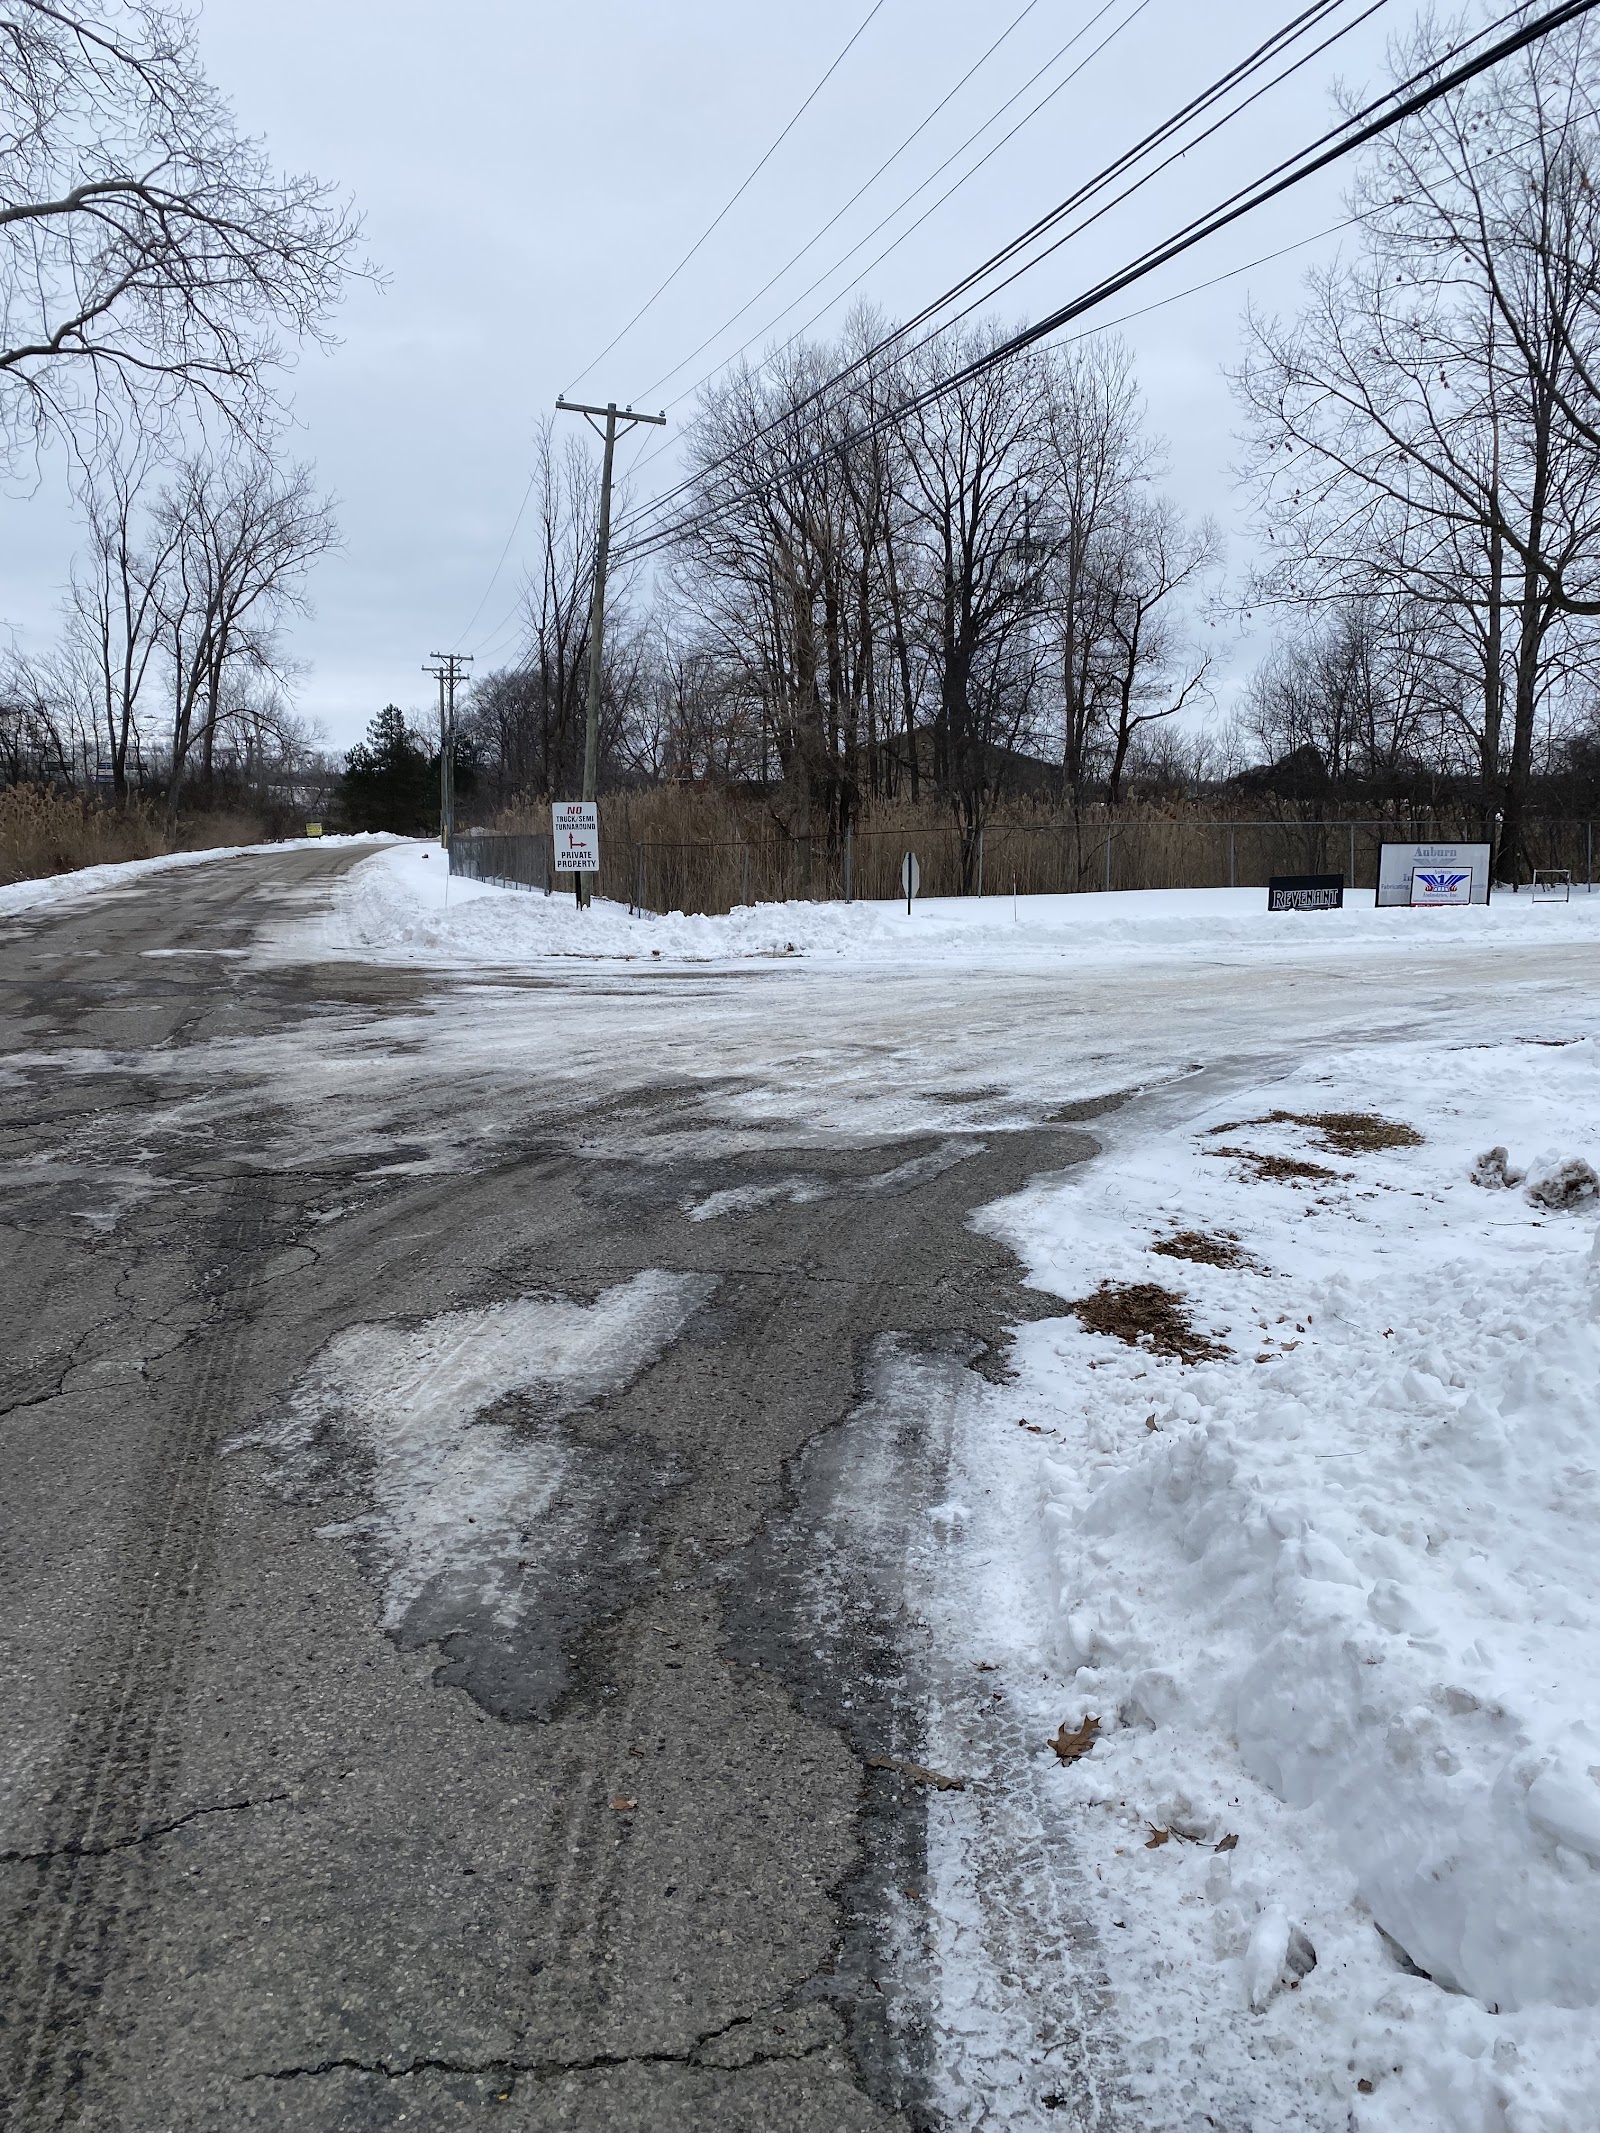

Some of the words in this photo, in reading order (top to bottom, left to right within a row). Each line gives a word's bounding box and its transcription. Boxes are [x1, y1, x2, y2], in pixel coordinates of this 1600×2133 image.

[567, 806, 583, 815] NO
[556, 815, 594, 823] TRUCK/SEMI
[555, 823, 596, 831] TURNAROUND
[561, 851, 592, 859] PRIVATE
[1414, 846, 1457, 857] Auburn
[557, 860, 597, 868] PROPERTY
[1272, 888, 1339, 909] REVENANT
